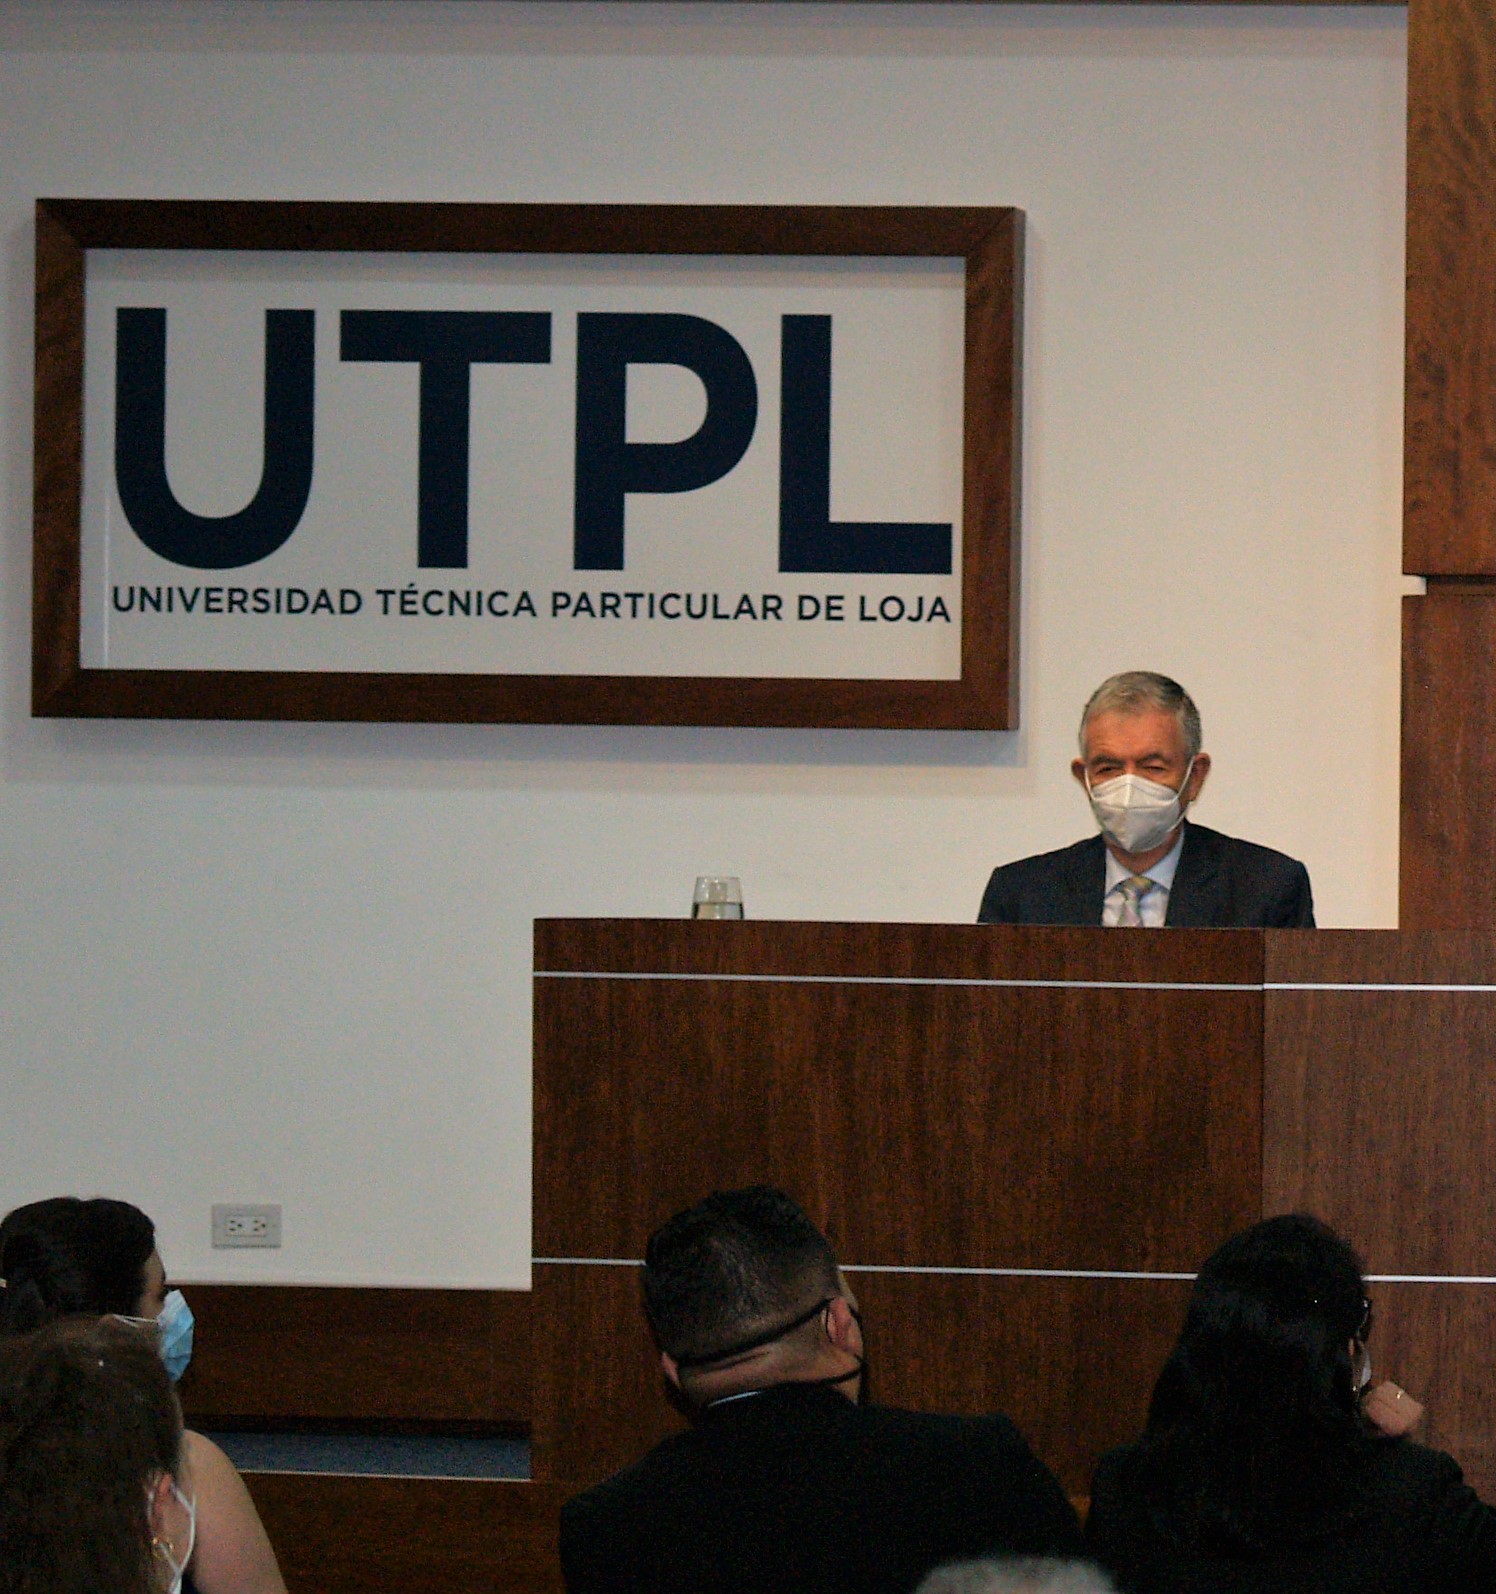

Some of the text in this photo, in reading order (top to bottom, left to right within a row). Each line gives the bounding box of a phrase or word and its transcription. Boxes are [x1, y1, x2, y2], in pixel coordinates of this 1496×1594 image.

[112, 305, 954, 576] UTPL
[111, 582, 952, 623] UNIVERSIDAD TÉCNICA PARTICULAR DE LOJA
